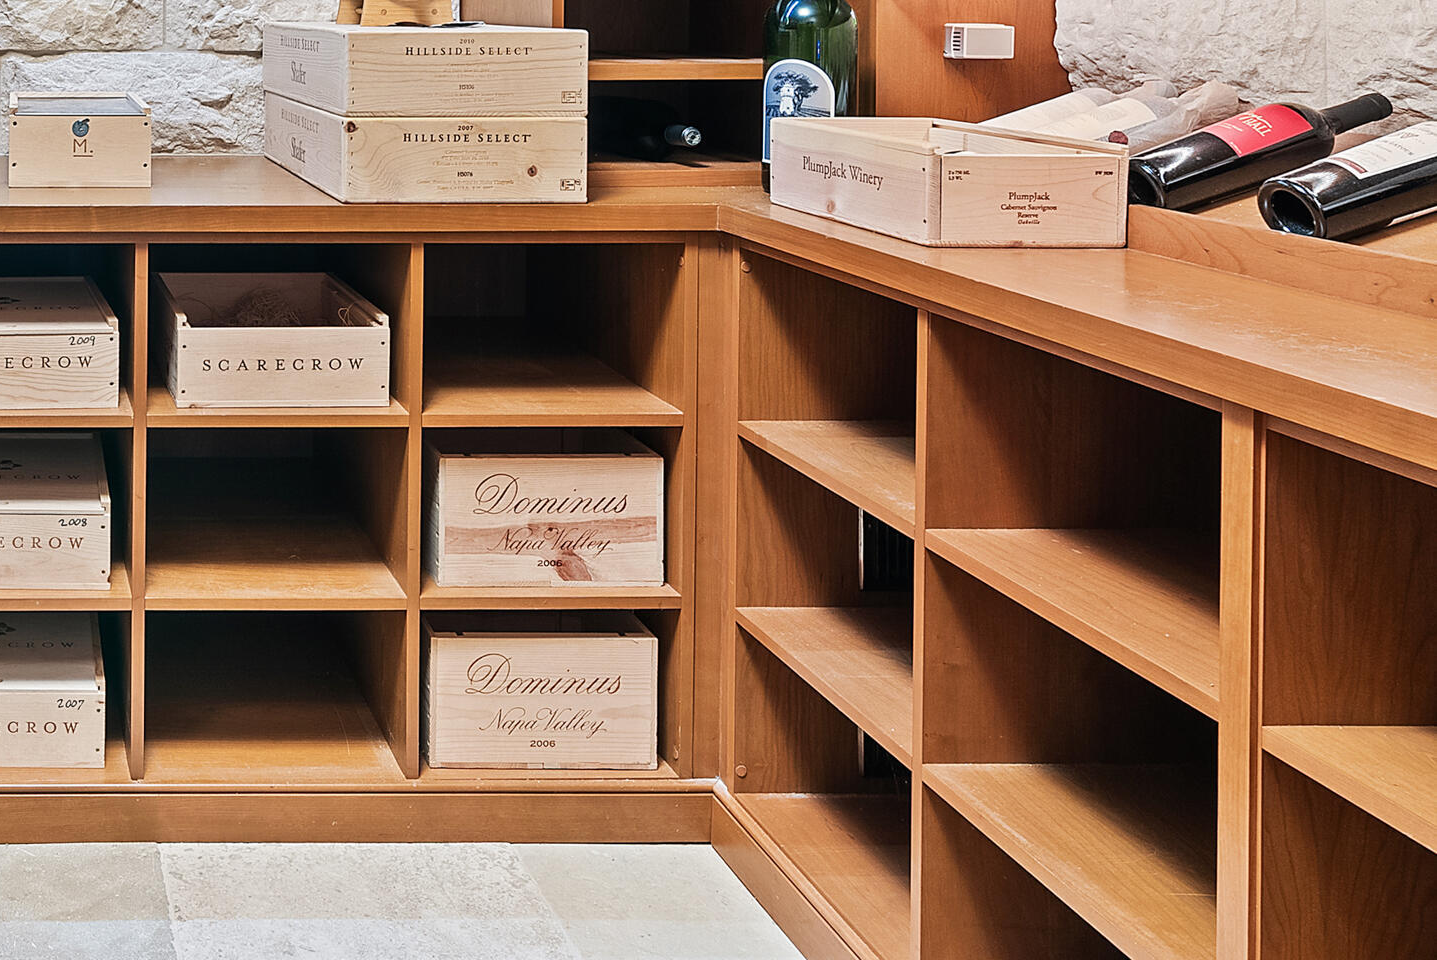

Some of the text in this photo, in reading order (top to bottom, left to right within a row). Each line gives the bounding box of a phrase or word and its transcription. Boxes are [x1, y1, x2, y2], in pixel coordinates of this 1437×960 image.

[405, 46, 472, 56] HILLSIDE
[403, 133, 470, 143] HILLSIDE
[802, 155, 884, 191] PlumpJack Winery
[1008, 191, 1051, 202] PlumpJack
[1000, 203, 1058, 212] Cabernet Sauvignon
[68, 336, 96, 346] 2009
[203, 357, 365, 373] SCARECROW
[473, 473, 628, 515] Dominus
[58, 517, 88, 527] 2008
[487, 527, 614, 558] Napa Valley
[464, 652, 622, 695] Dominus
[56, 698, 85, 710] 2007
[479, 707, 607, 739] Napa Valley
[529, 740, 556, 748] 2006
